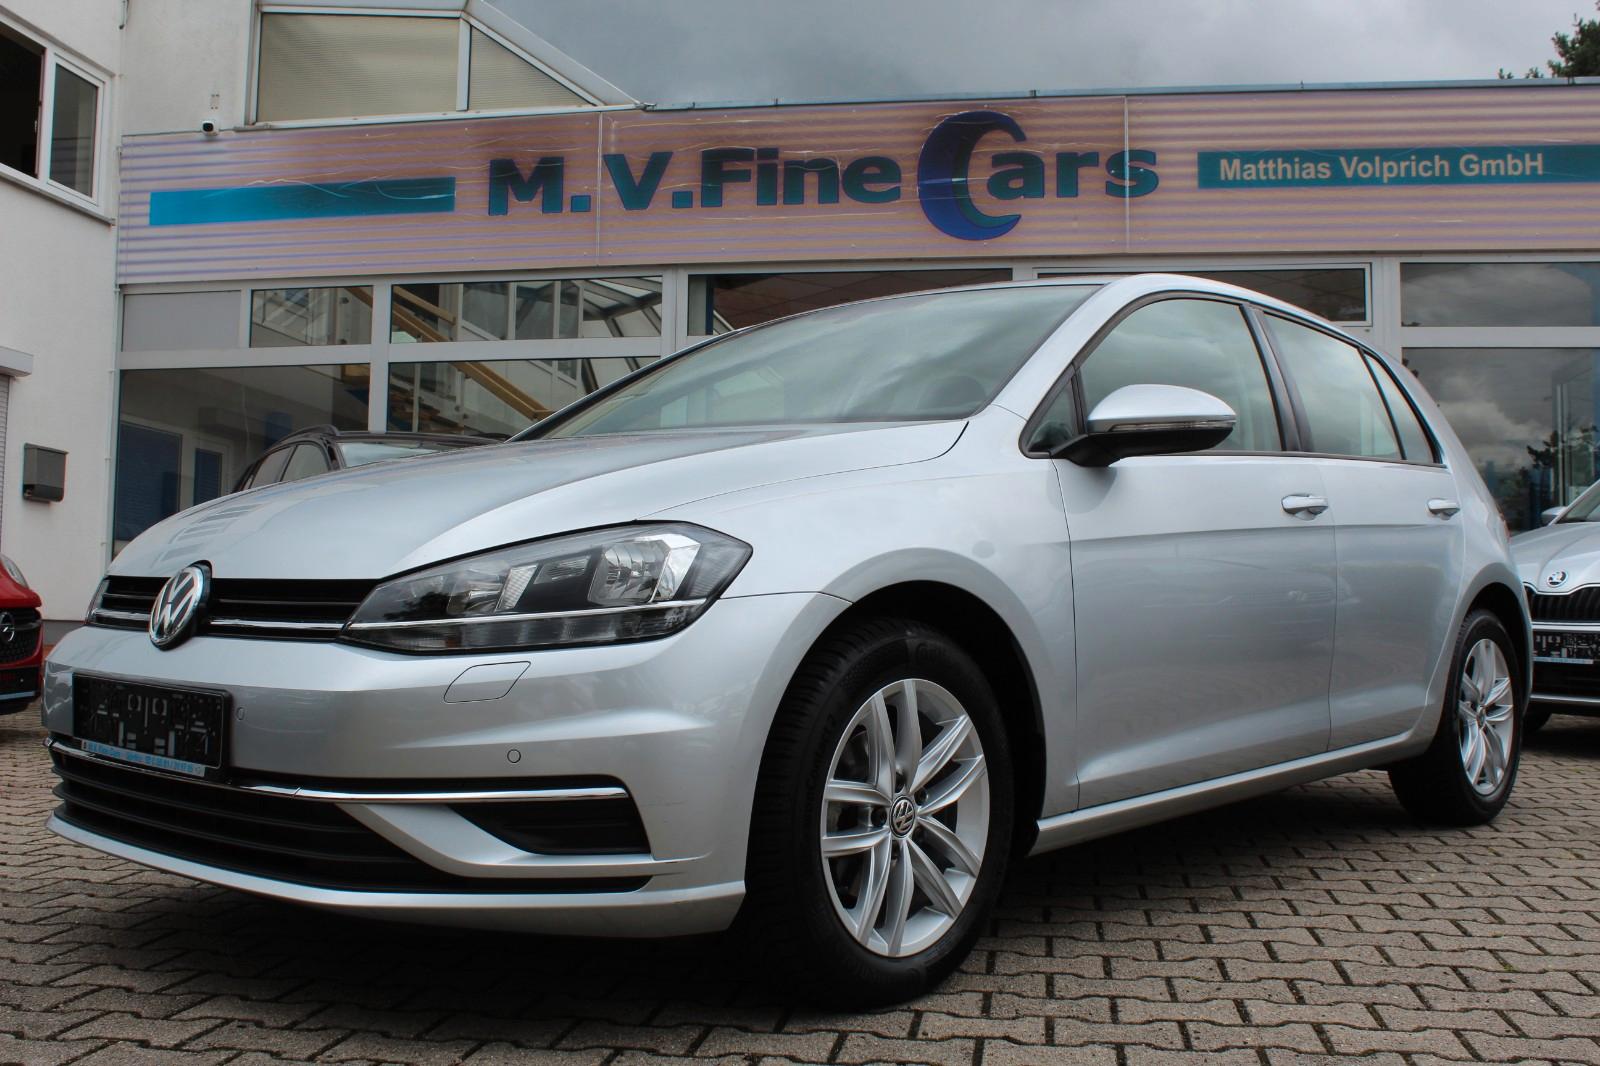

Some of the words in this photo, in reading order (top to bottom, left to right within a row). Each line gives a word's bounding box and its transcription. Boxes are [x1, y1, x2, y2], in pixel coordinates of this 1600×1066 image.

[917, 110, 1160, 241] Cars
[1219, 158, 1332, 181] Matthias
[1339, 155, 1450, 183] Volprich
[1459, 152, 1545, 177] GmbH
